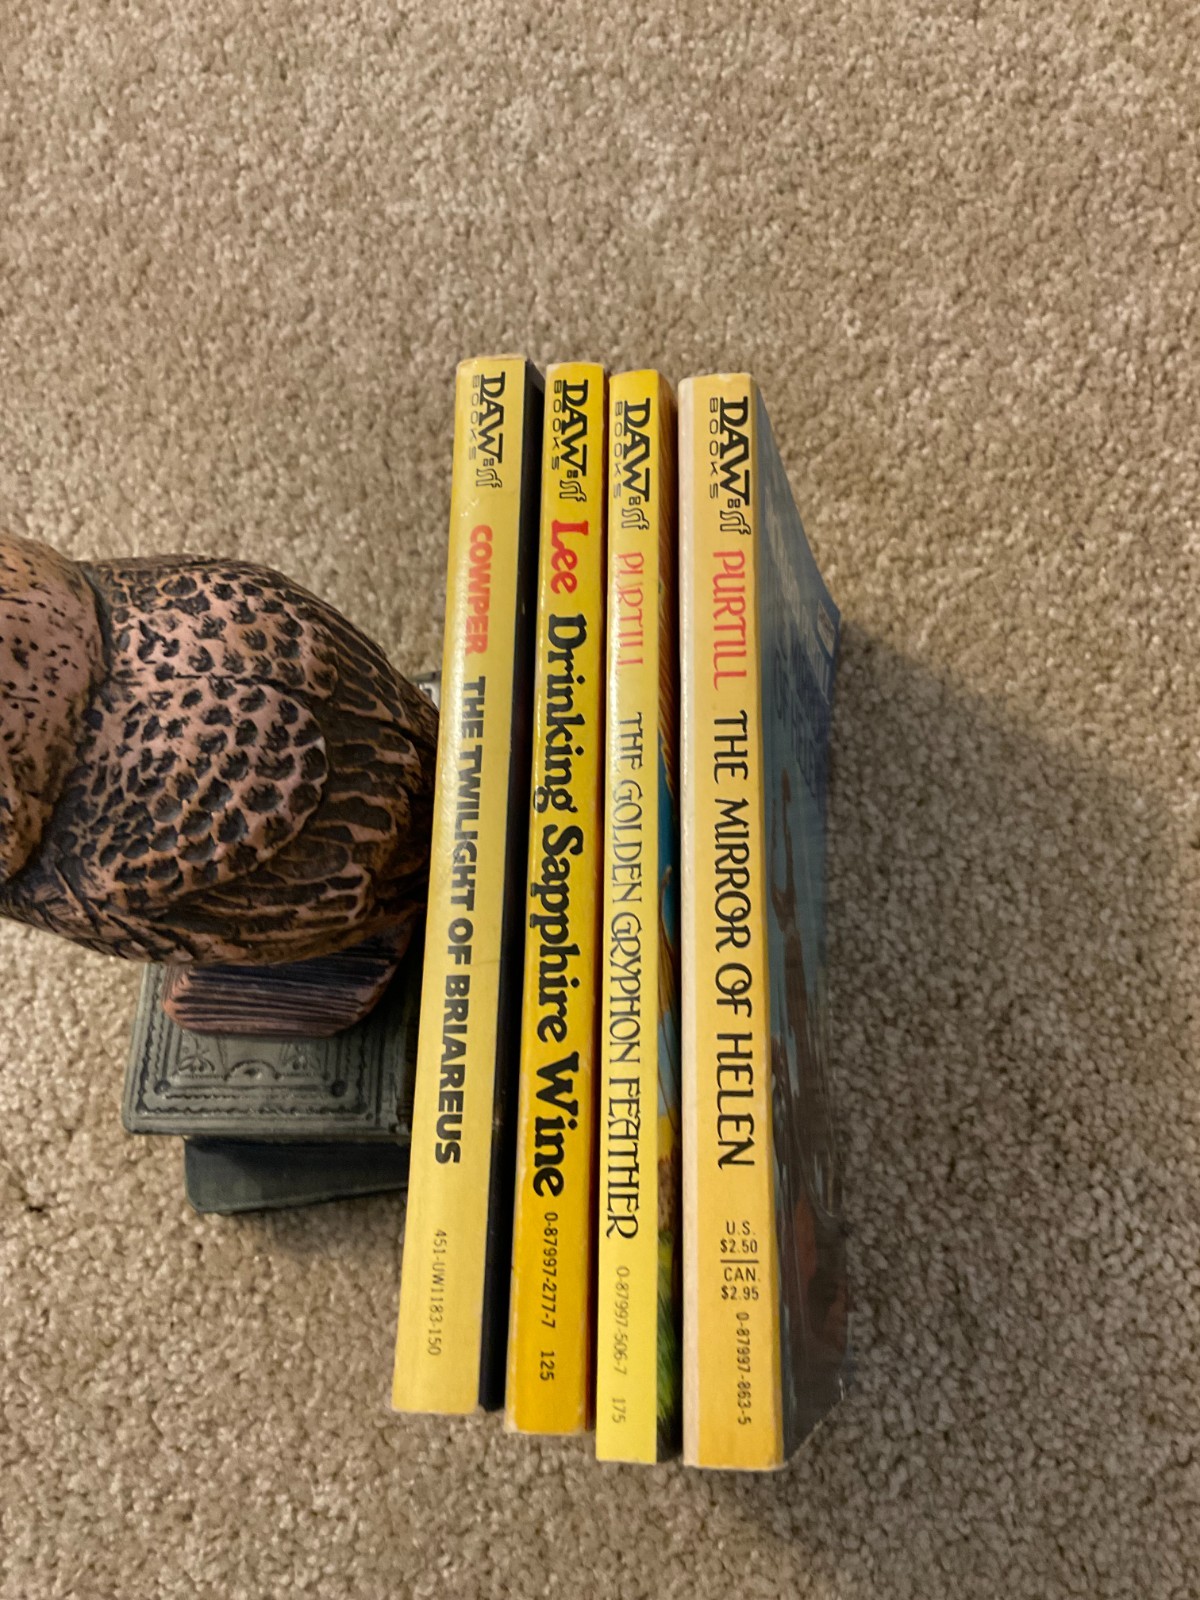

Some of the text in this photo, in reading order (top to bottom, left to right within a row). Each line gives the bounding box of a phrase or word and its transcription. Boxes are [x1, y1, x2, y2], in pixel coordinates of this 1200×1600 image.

[469, 375, 480, 460] BOOKS
[551, 380, 562, 470] BOOKS
[614, 402, 623, 498] BOOKS
[709, 398, 719, 499] BOOKS
[617, 712, 643, 771] THE
[435, 525, 492, 1164] COWPER THE TWILIGHT OF BRIAREUS
[530, 519, 589, 1197] Lee Drinking Sapphire Wine
[611, 779, 643, 903] GOLDEN
[713, 550, 755, 1170] PURTILL THE MIRROR OF HELEN
[610, 912, 642, 1064] GRYPHON
[606, 1077, 640, 1239] FEATHER
[720, 1238, 758, 1254] $2.50
[723, 1267, 761, 1282] CAN.
[726, 1220, 756, 1236] U.S.
[540, 1212, 558, 1381] 0-87997-277-7 125
[721, 1285, 760, 1301] $2.95
[612, 1398, 626, 1424] 175
